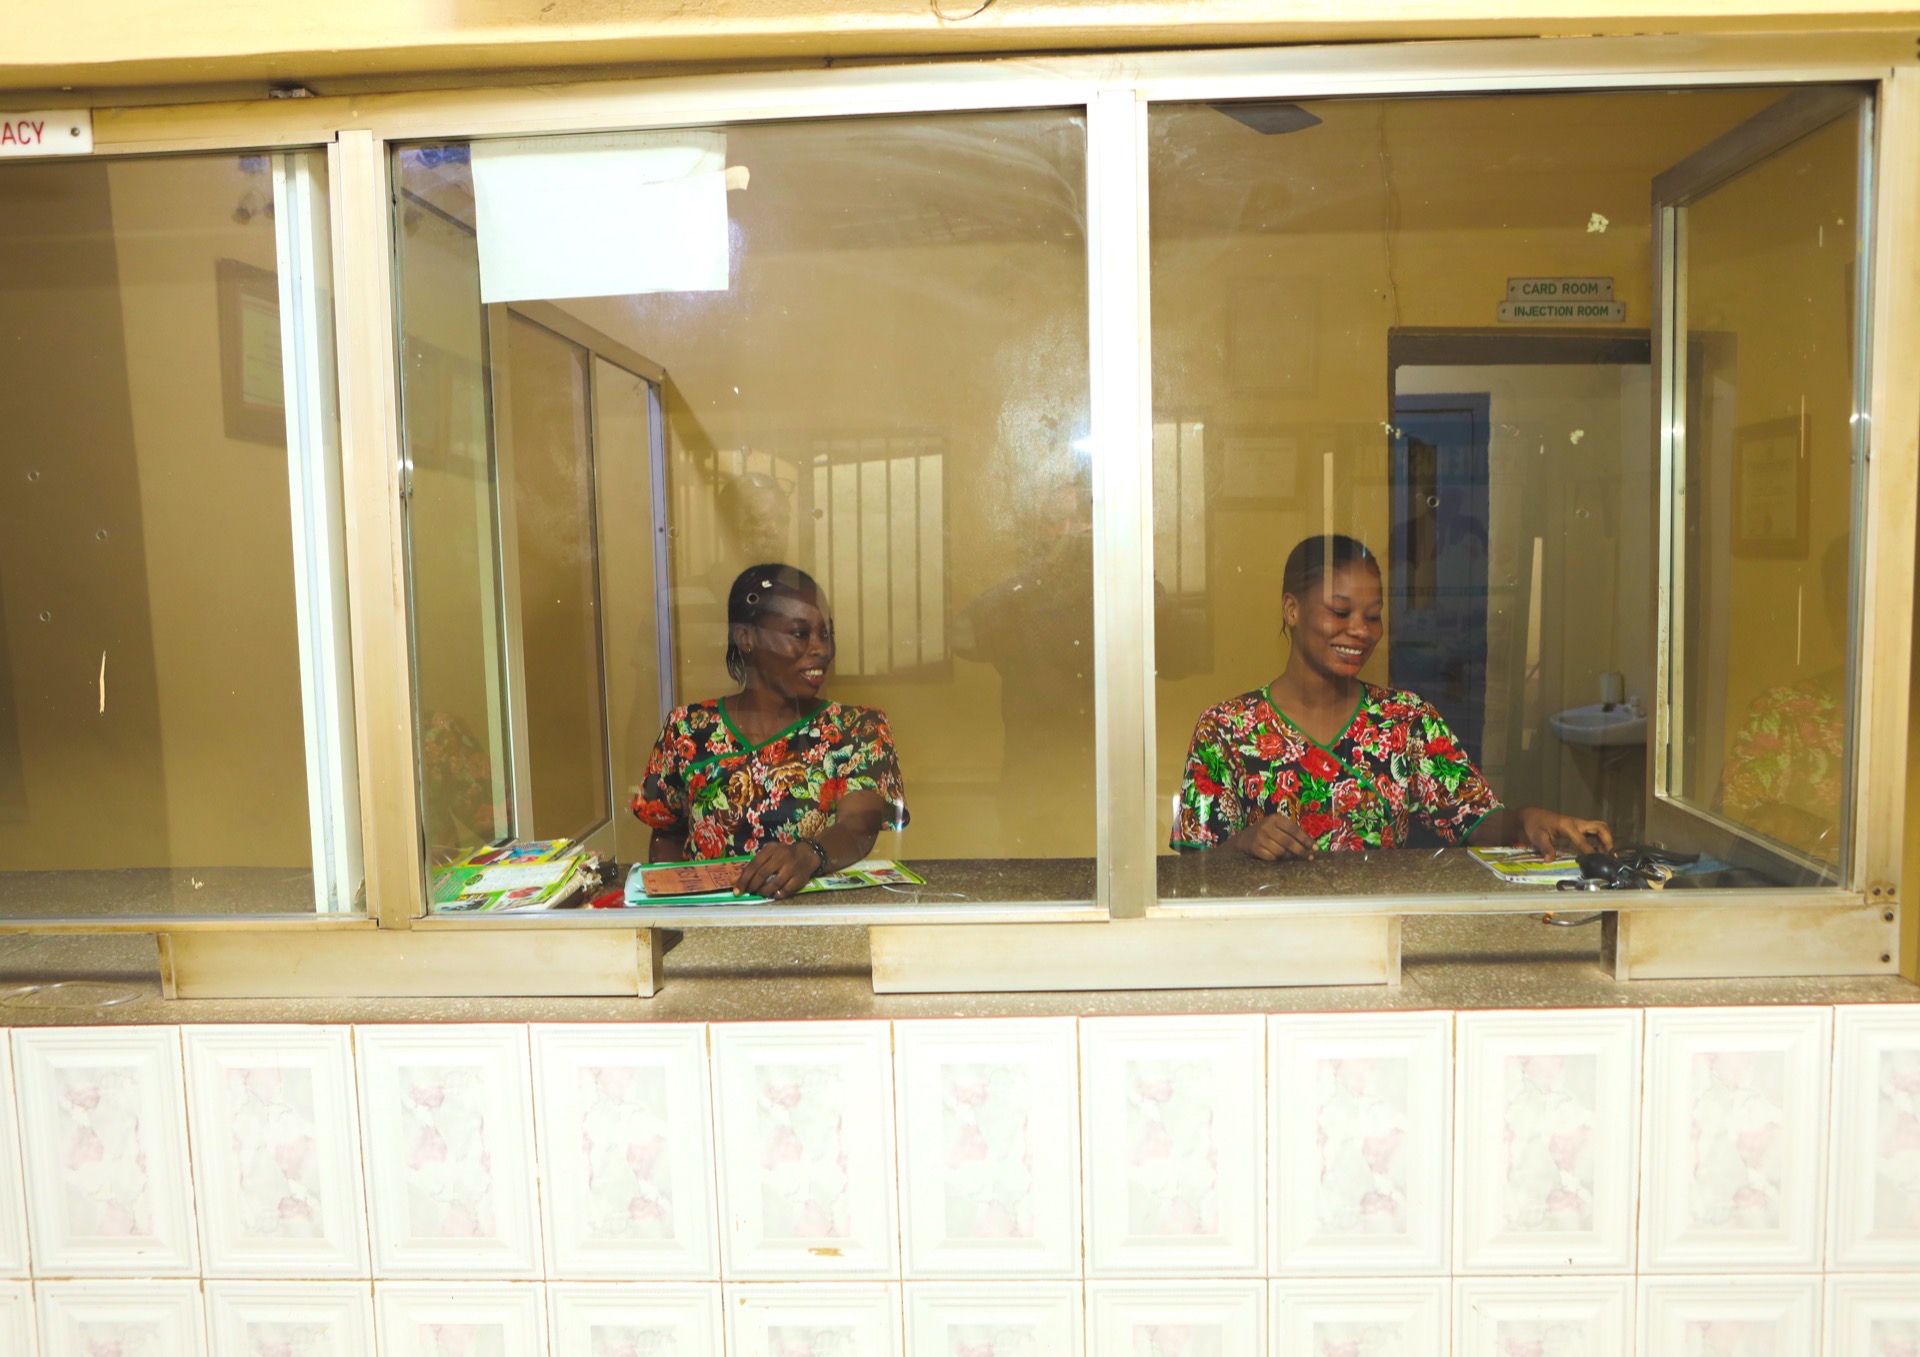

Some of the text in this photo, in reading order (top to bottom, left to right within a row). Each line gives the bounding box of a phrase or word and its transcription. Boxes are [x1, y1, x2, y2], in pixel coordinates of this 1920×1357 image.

[1, 121, 44, 145] ACY
[1522, 283, 1598, 295] CARD ROOM
[1514, 305, 1609, 316] INJECTION ROOM
